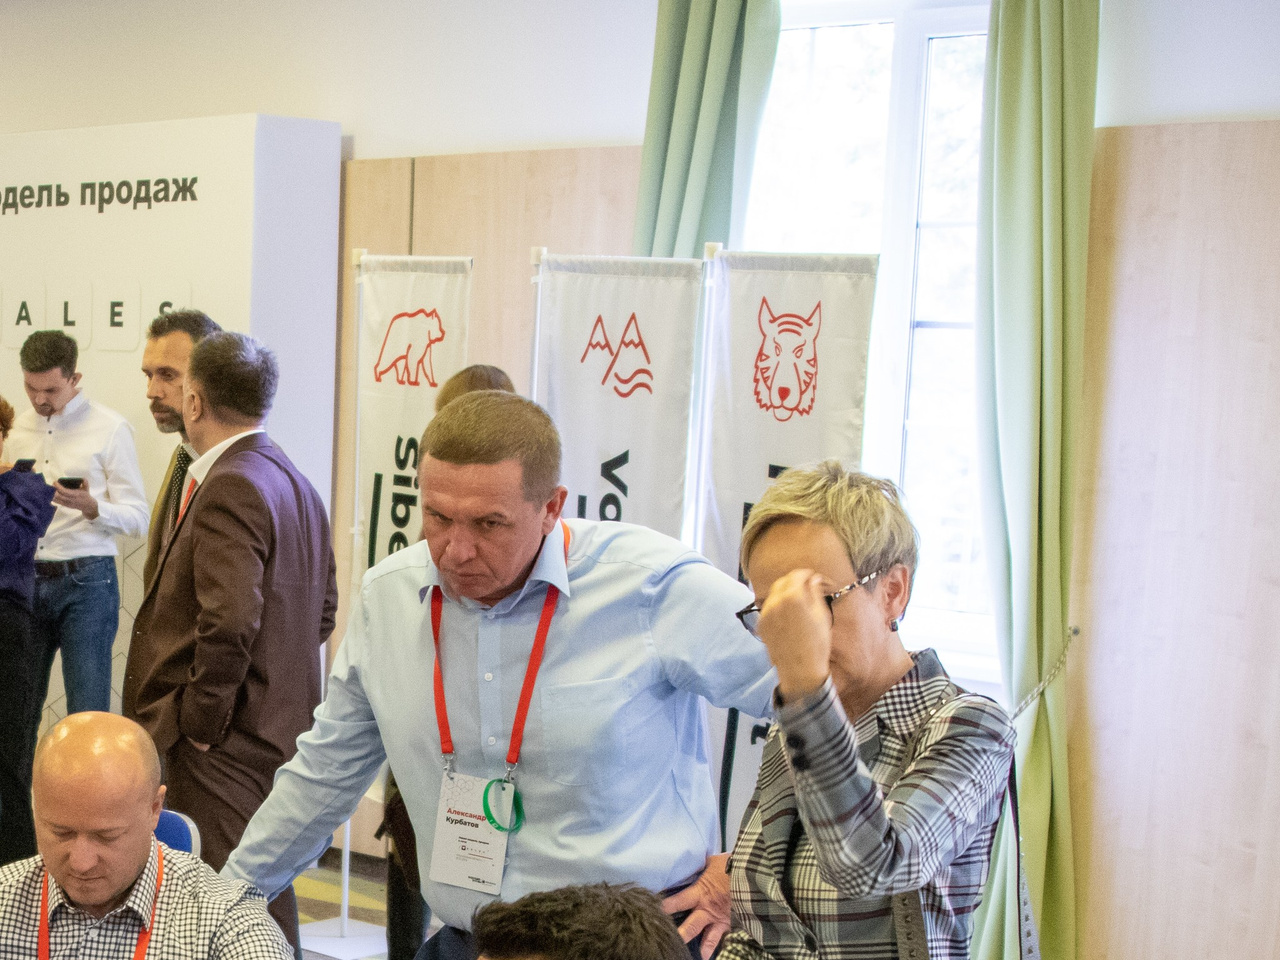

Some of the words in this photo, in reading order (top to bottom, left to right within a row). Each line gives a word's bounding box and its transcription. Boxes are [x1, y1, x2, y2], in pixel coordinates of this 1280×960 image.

[80, 176, 198, 214] продаж
[446, 807, 487, 822] Александр
[445, 816, 480, 829] Курбатов
